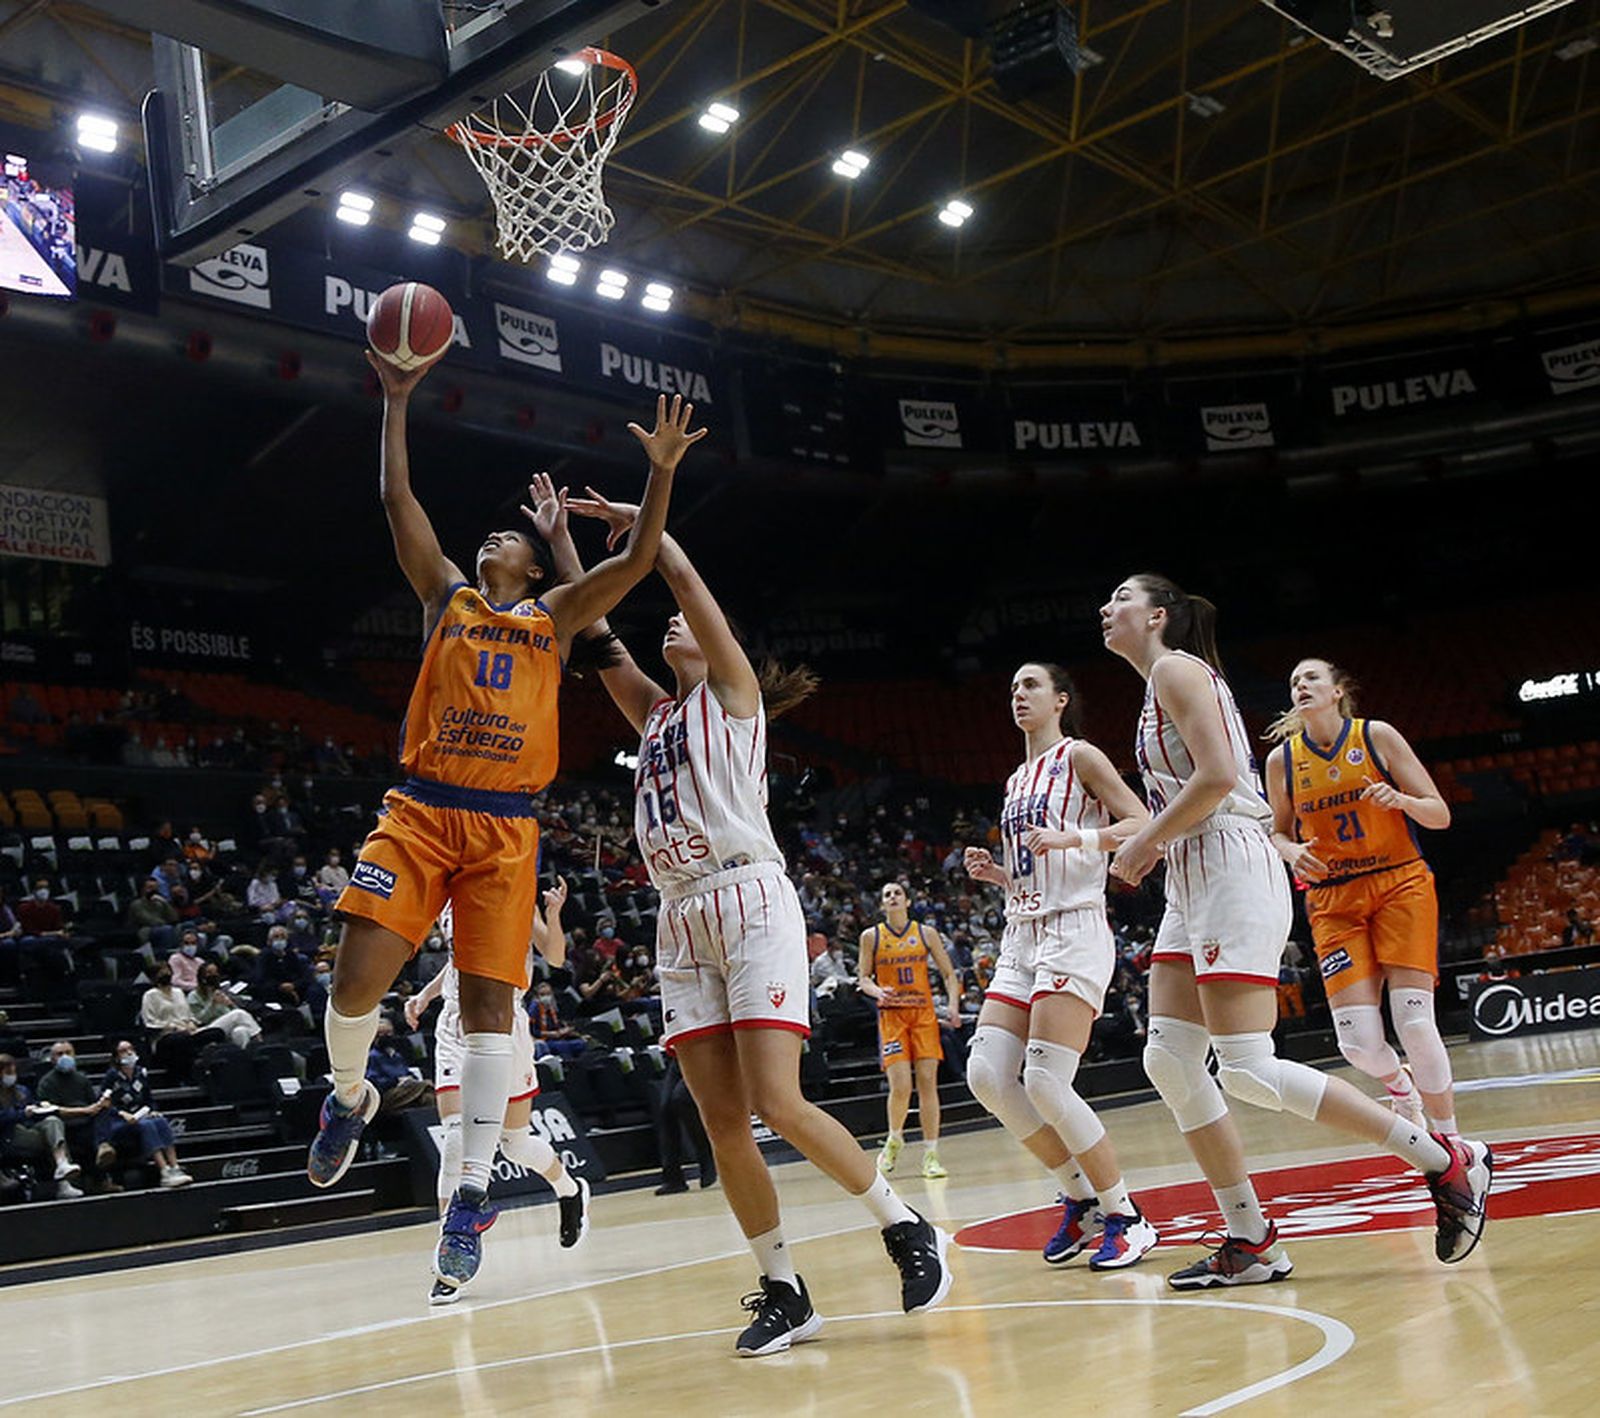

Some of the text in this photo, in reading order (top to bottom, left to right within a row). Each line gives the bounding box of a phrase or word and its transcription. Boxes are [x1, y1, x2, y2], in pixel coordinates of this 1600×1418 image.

[213, 250, 263, 272] LEVA
[325, 275, 472, 348] PUA
[500, 310, 554, 340] PULEVA
[601, 343, 712, 404] PULEVA
[1331, 369, 1476, 416] PULEVA
[904, 405, 954, 421] PULEVA
[1206, 411, 1265, 426] PULEVA
[1014, 420, 1141, 450] PULEVA
[0, 507, 91, 532] PORTIVA
[160, 628, 252, 660] POSSIBLE
[474, 650, 513, 690] 18
[442, 706, 509, 730] Cultura
[644, 785, 677, 830] 15
[1333, 810, 1366, 843] 21
[897, 966, 914, 985] 10
